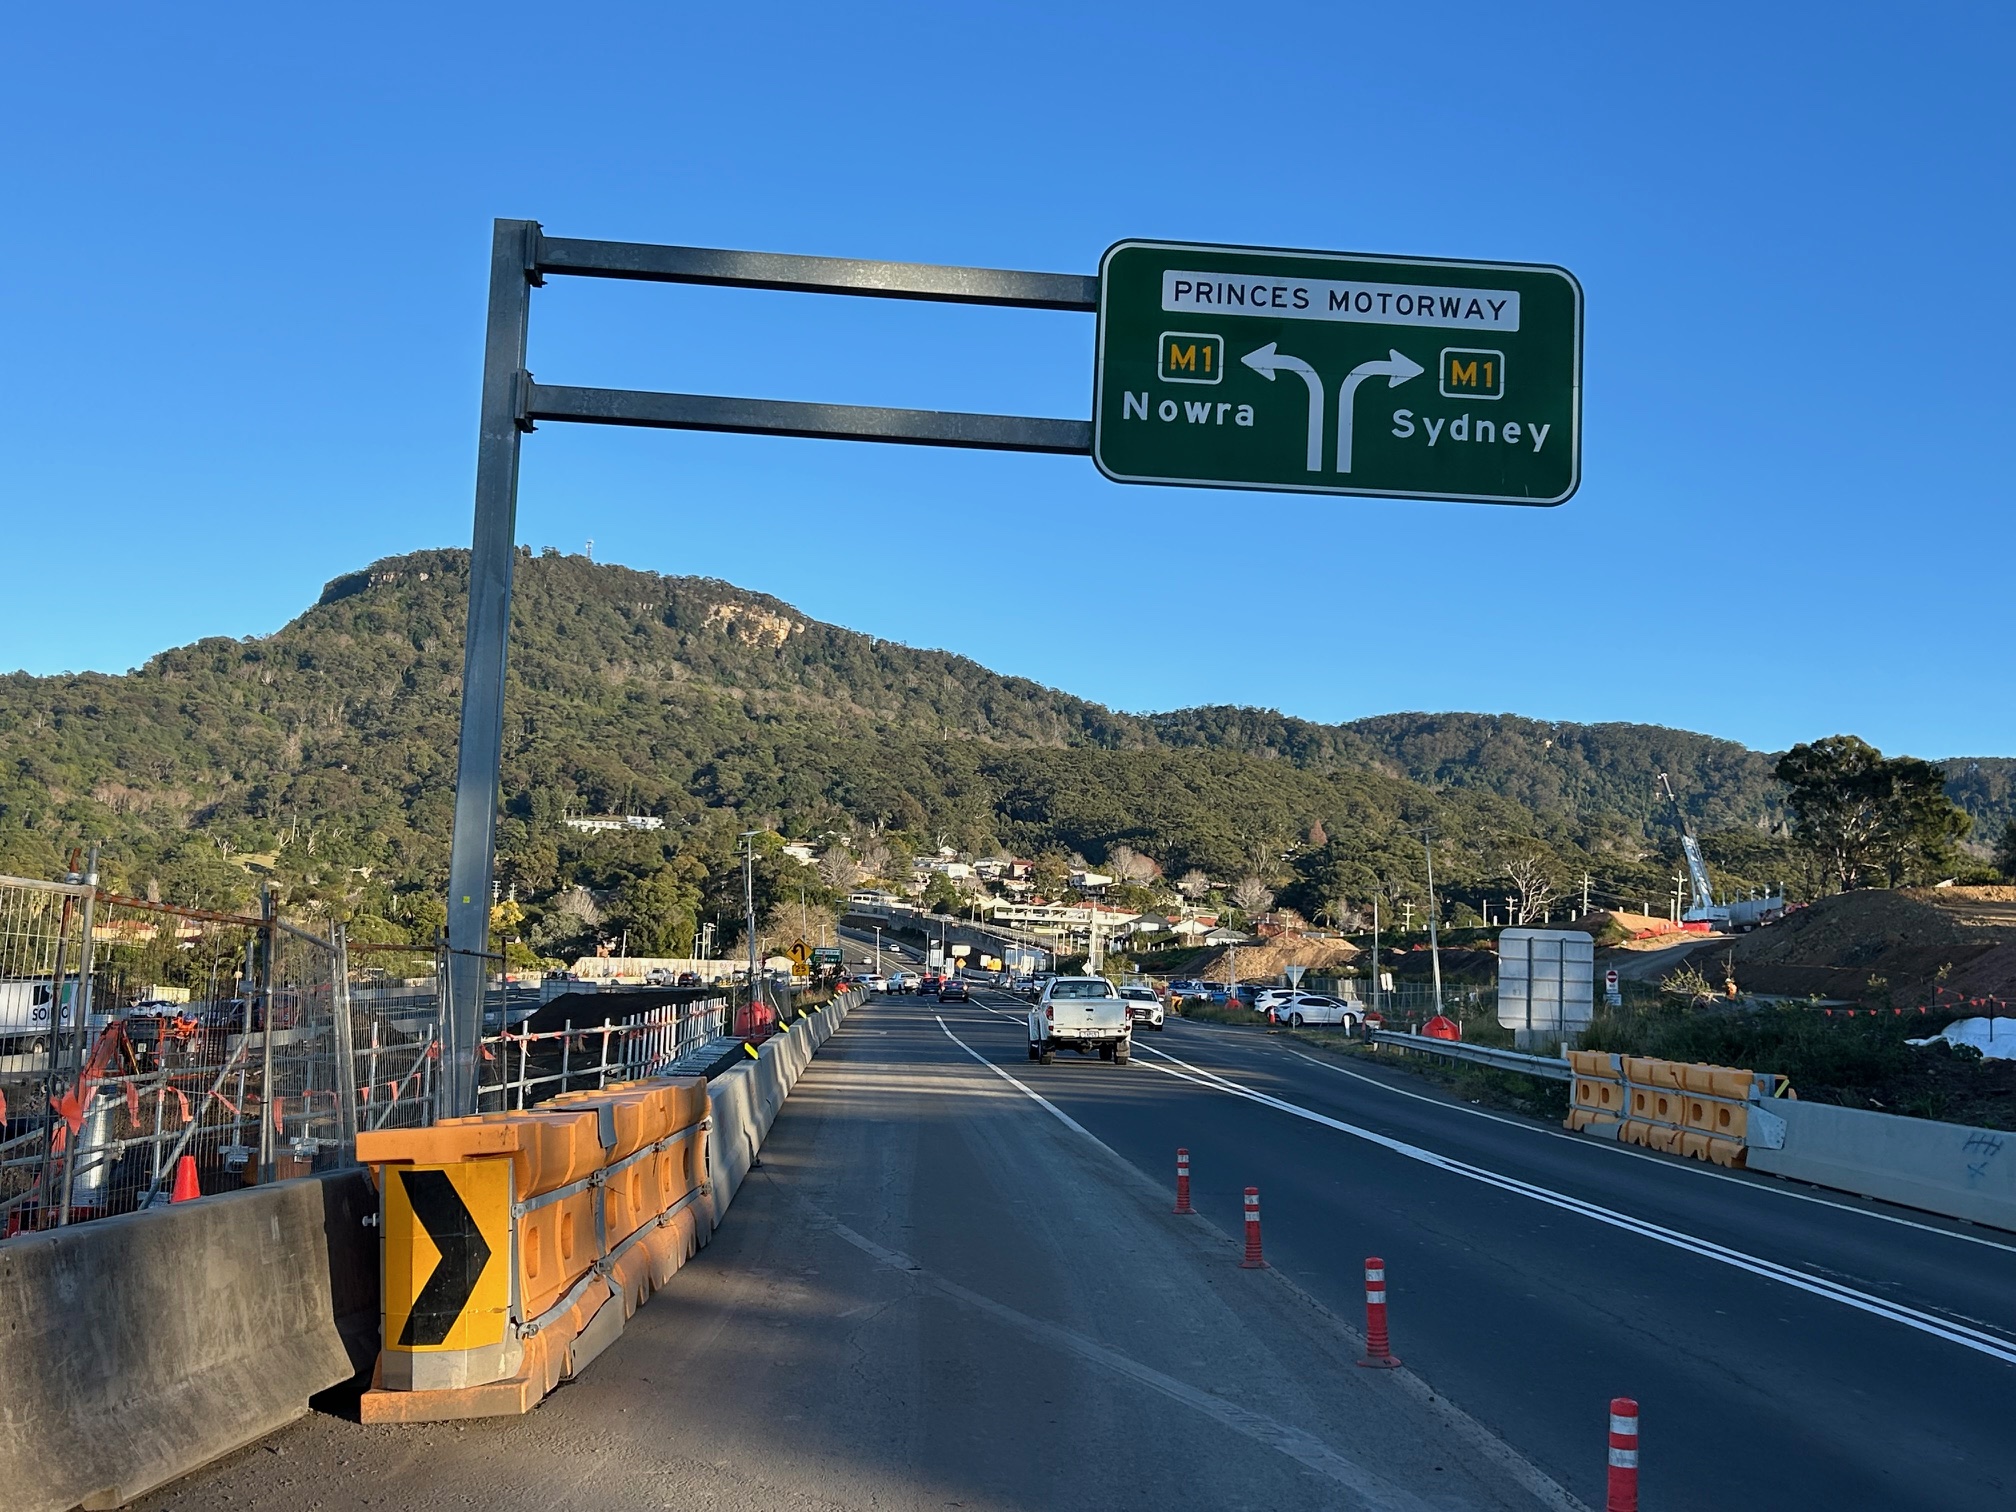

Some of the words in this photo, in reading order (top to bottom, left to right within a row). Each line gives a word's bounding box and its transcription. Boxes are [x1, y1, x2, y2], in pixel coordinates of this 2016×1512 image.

[1174, 280, 1310, 309] PRINCES
[1328, 289, 1508, 321] MOTORWAY
[1170, 344, 1213, 373] M1
[1451, 359, 1494, 389] M1
[1123, 391, 1254, 427] Nowra
[1391, 409, 1551, 453] Sydney
